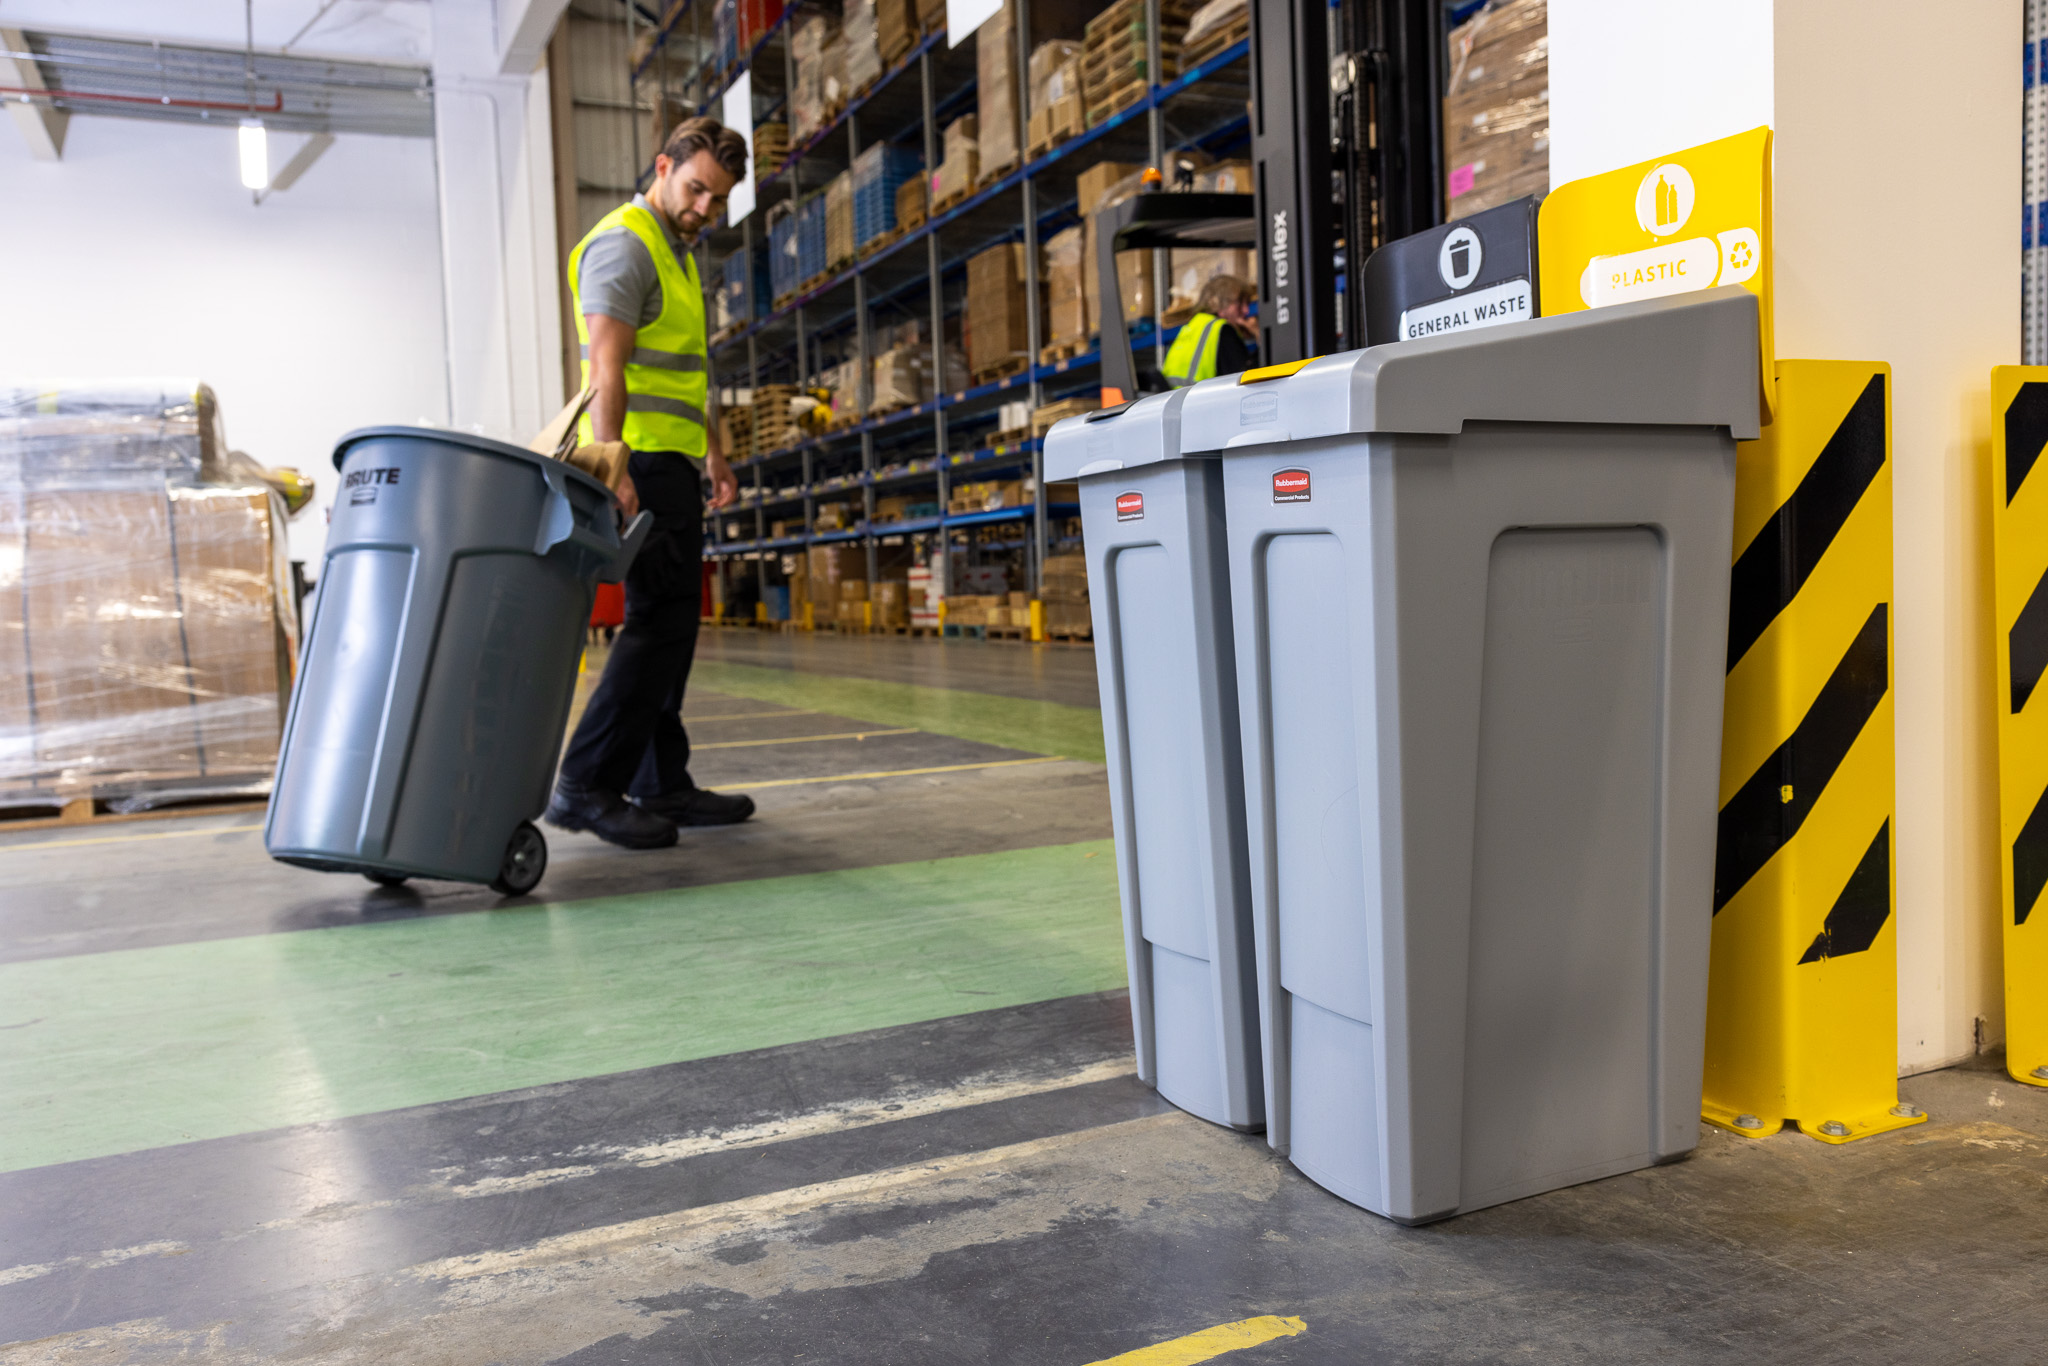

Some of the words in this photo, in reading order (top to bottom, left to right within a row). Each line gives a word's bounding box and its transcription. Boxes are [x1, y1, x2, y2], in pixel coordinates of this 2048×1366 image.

[1611, 259, 1687, 289] PLASTIC
[1277, 294, 1289, 325] BT
[1408, 311, 1469, 338] GENERAL
[1474, 295, 1525, 321] WASTE
[345, 467, 401, 488] BRUTE
[1275, 478, 1307, 487] Rubbermaid
